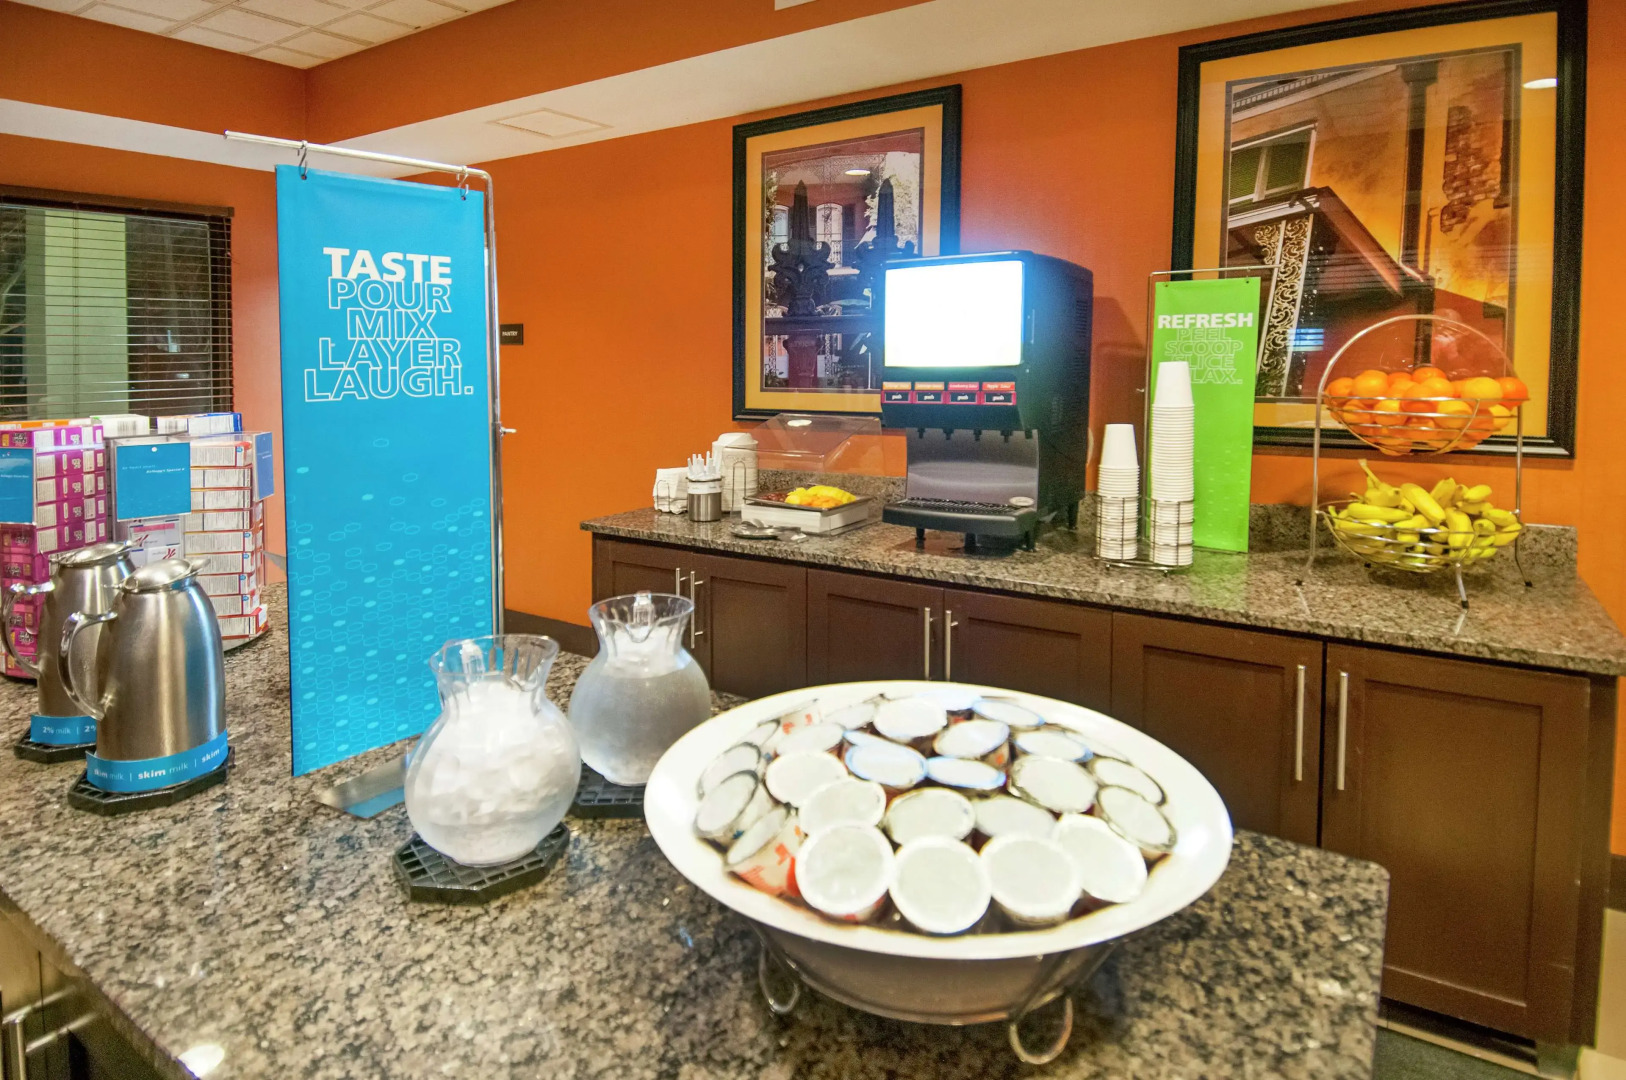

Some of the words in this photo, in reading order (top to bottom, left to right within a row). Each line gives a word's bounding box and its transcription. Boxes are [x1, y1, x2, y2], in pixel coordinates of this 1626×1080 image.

[323, 247, 452, 285] TASTE
[328, 277, 452, 313] POUR
[347, 308, 437, 340] MIX
[1157, 312, 1253, 328] REFRESH
[1177, 328, 1231, 341] PEEL
[319, 337, 462, 370] LAYER
[1164, 340, 1244, 356] SCOOP
[304, 366, 474, 402] LAUGH.
[1191, 368, 1243, 384] LAX.
[42, 726, 54, 734] 2%
[201, 748, 220, 763] skim
[138, 768, 166, 780] skim
[169, 762, 189, 774] milk
